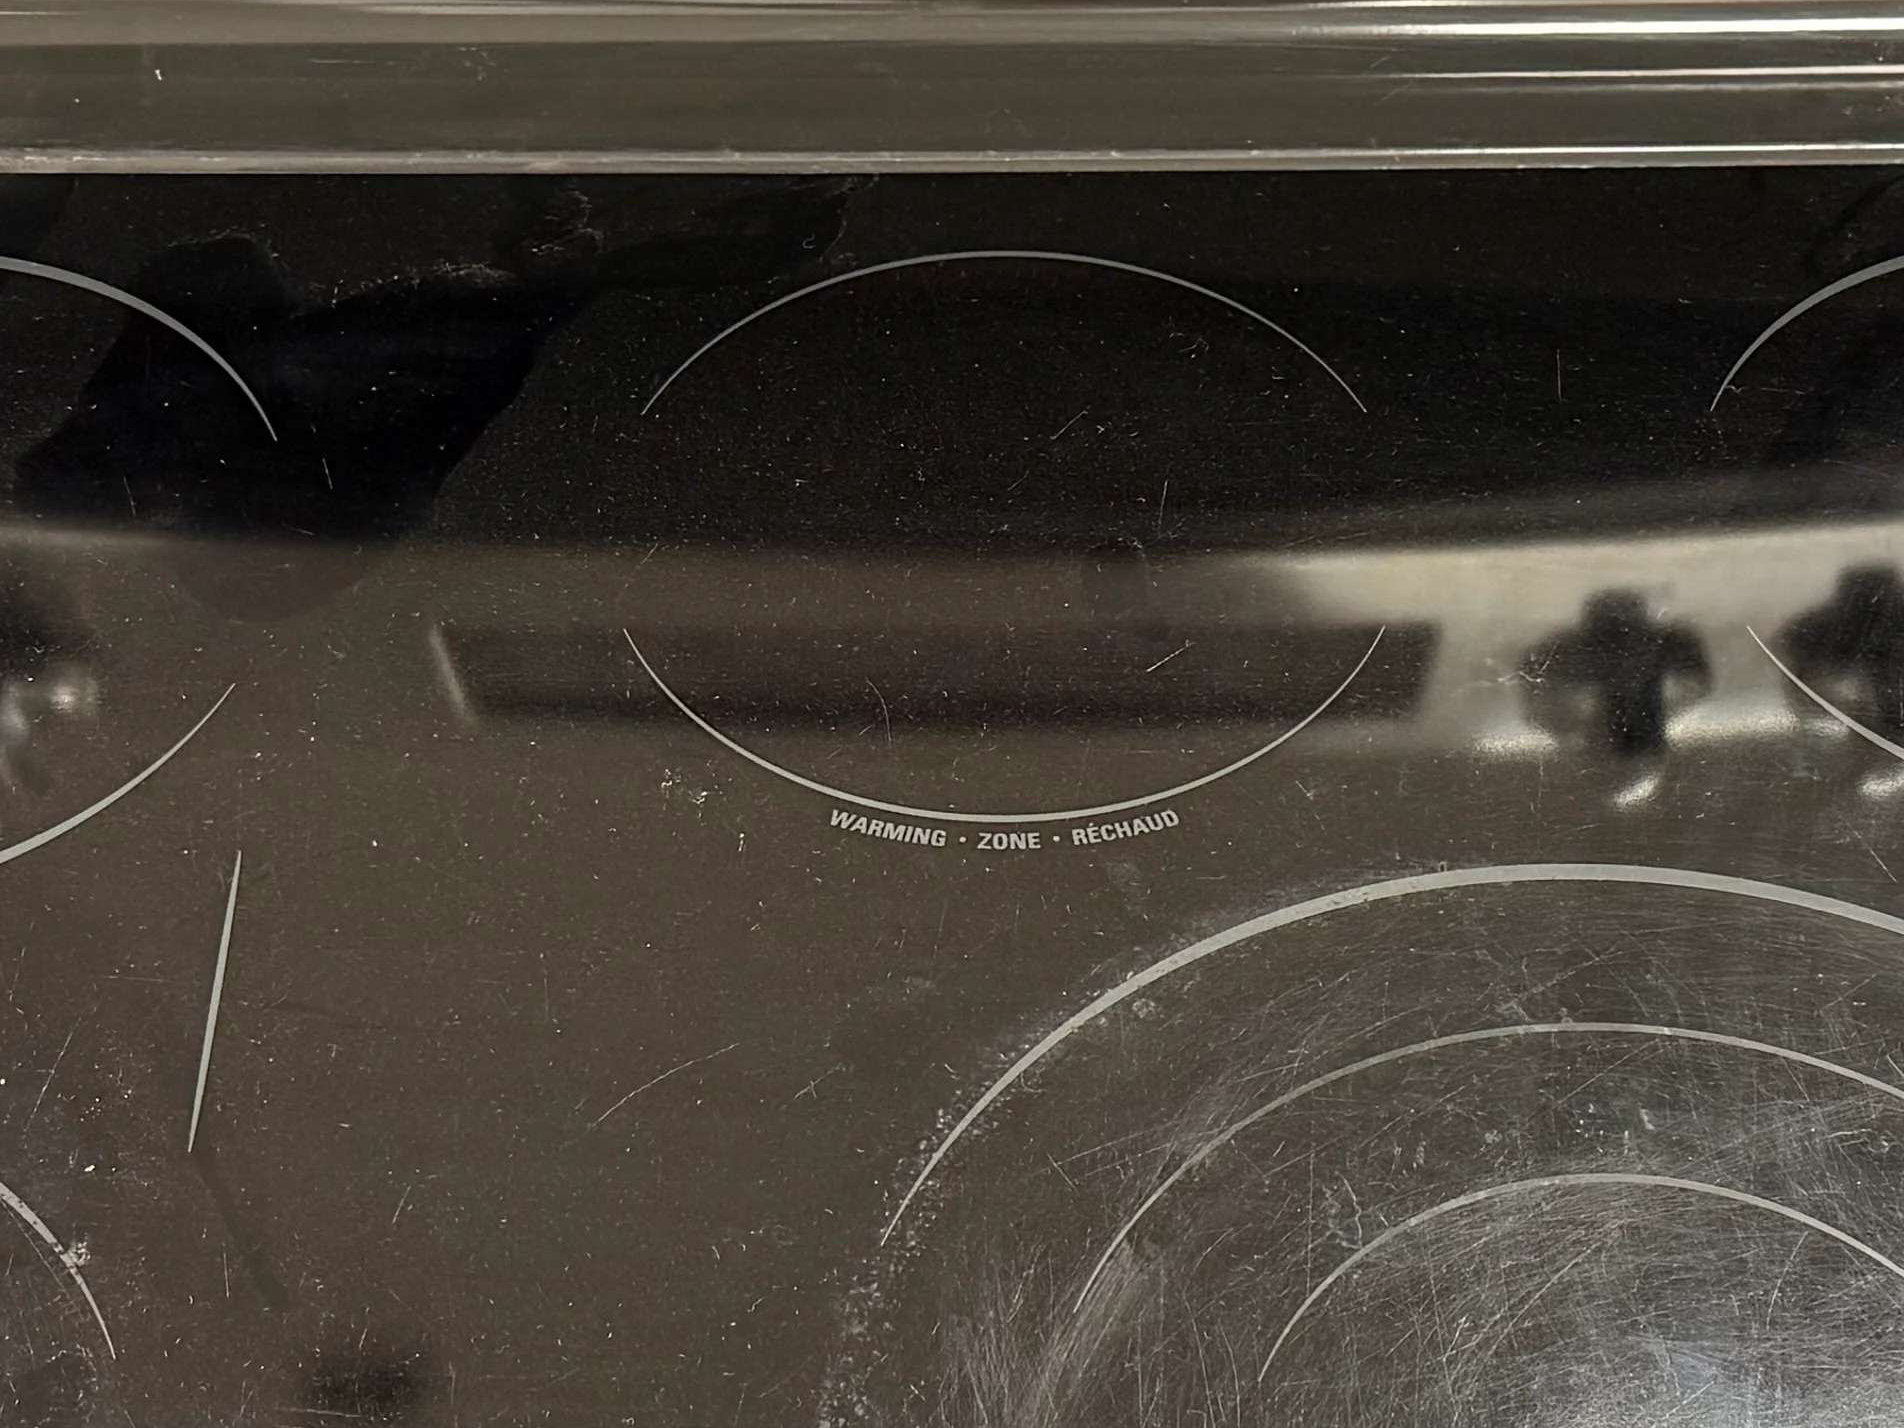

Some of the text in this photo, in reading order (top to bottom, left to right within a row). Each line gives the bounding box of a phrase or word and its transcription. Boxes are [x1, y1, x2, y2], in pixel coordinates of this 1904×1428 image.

[830, 809, 1180, 850] WARMING ZONE RÉCHAUD
